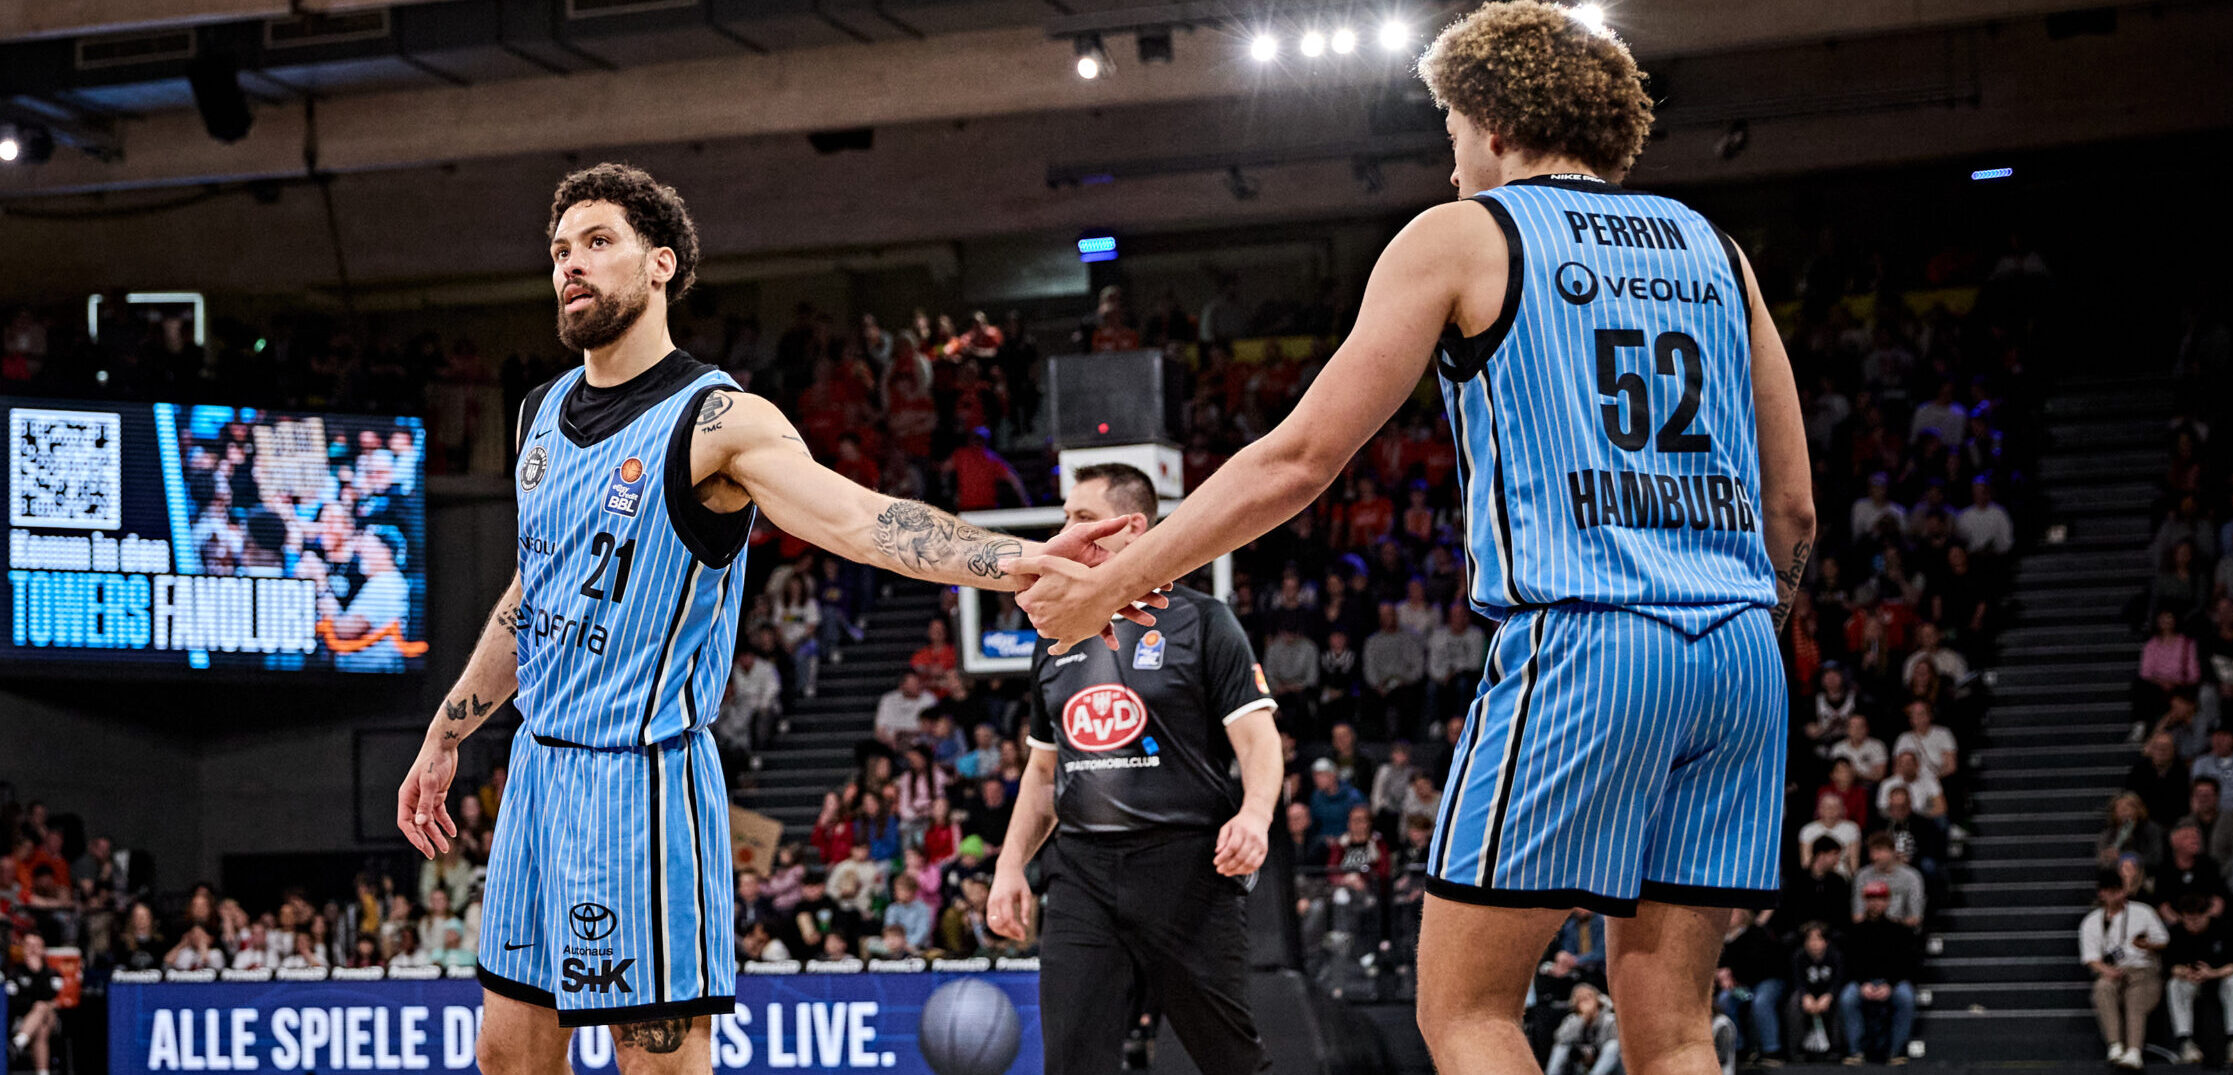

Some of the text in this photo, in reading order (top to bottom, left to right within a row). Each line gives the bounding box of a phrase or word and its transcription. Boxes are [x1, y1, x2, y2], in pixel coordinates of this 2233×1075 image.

[1564, 210, 1687, 250] PERRIN
[1604, 275, 1723, 306] VEOLIA
[1594, 329, 1711, 453] 52
[701, 421, 723, 435] TMC
[608, 496, 635, 513] BBL
[1567, 469, 1756, 532] HAMBURG
[580, 532, 636, 604] 21
[8, 570, 150, 649] TOWERS
[563, 945, 614, 956] Autohaus
[561, 958, 636, 994] S+K
[148, 1008, 260, 1070] ALLE
[271, 1006, 431, 1070] SPIELE
[766, 1001, 897, 1068] LIVE.
